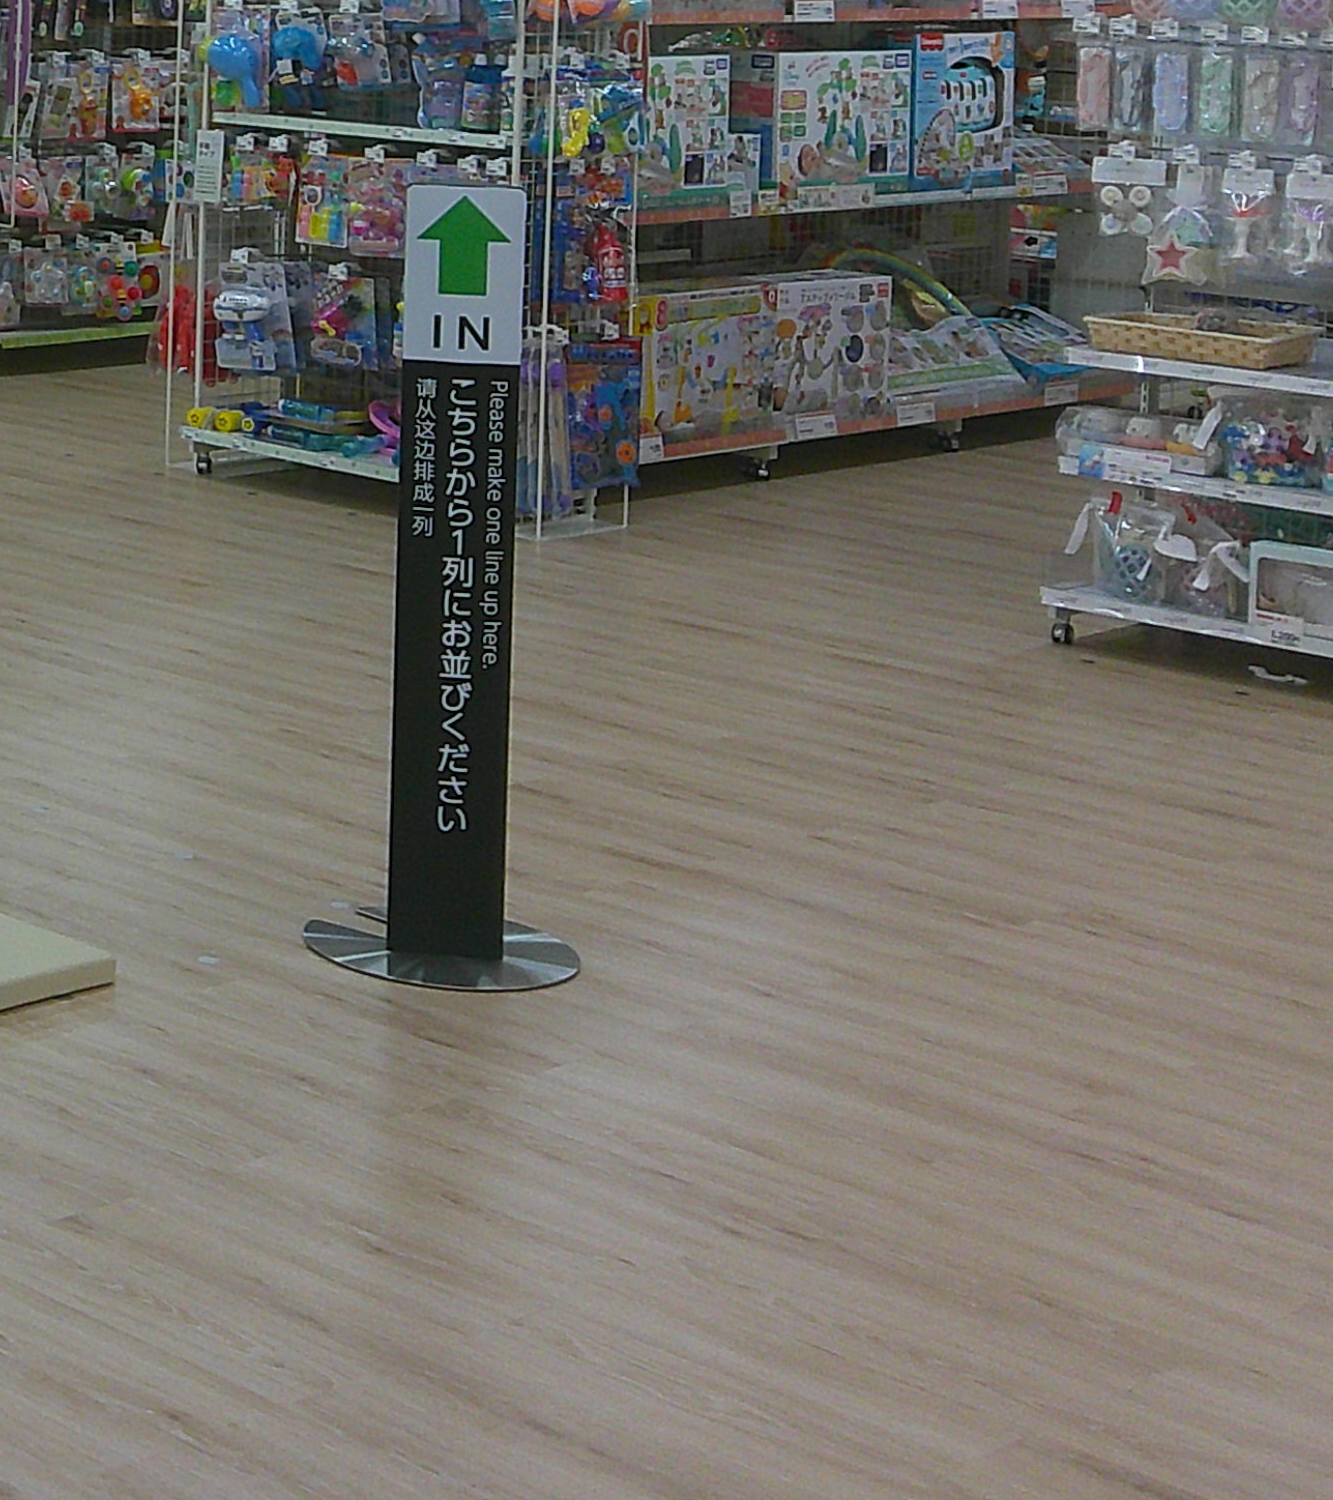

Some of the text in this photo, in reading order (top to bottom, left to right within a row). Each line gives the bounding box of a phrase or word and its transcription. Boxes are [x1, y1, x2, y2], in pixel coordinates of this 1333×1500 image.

[433, 314, 491, 352] IN
[411, 377, 437, 538] 请从这边排成一列
[479, 380, 509, 670] Please make one line up here.
[435, 378, 477, 833] こちらから1列にお並びください
